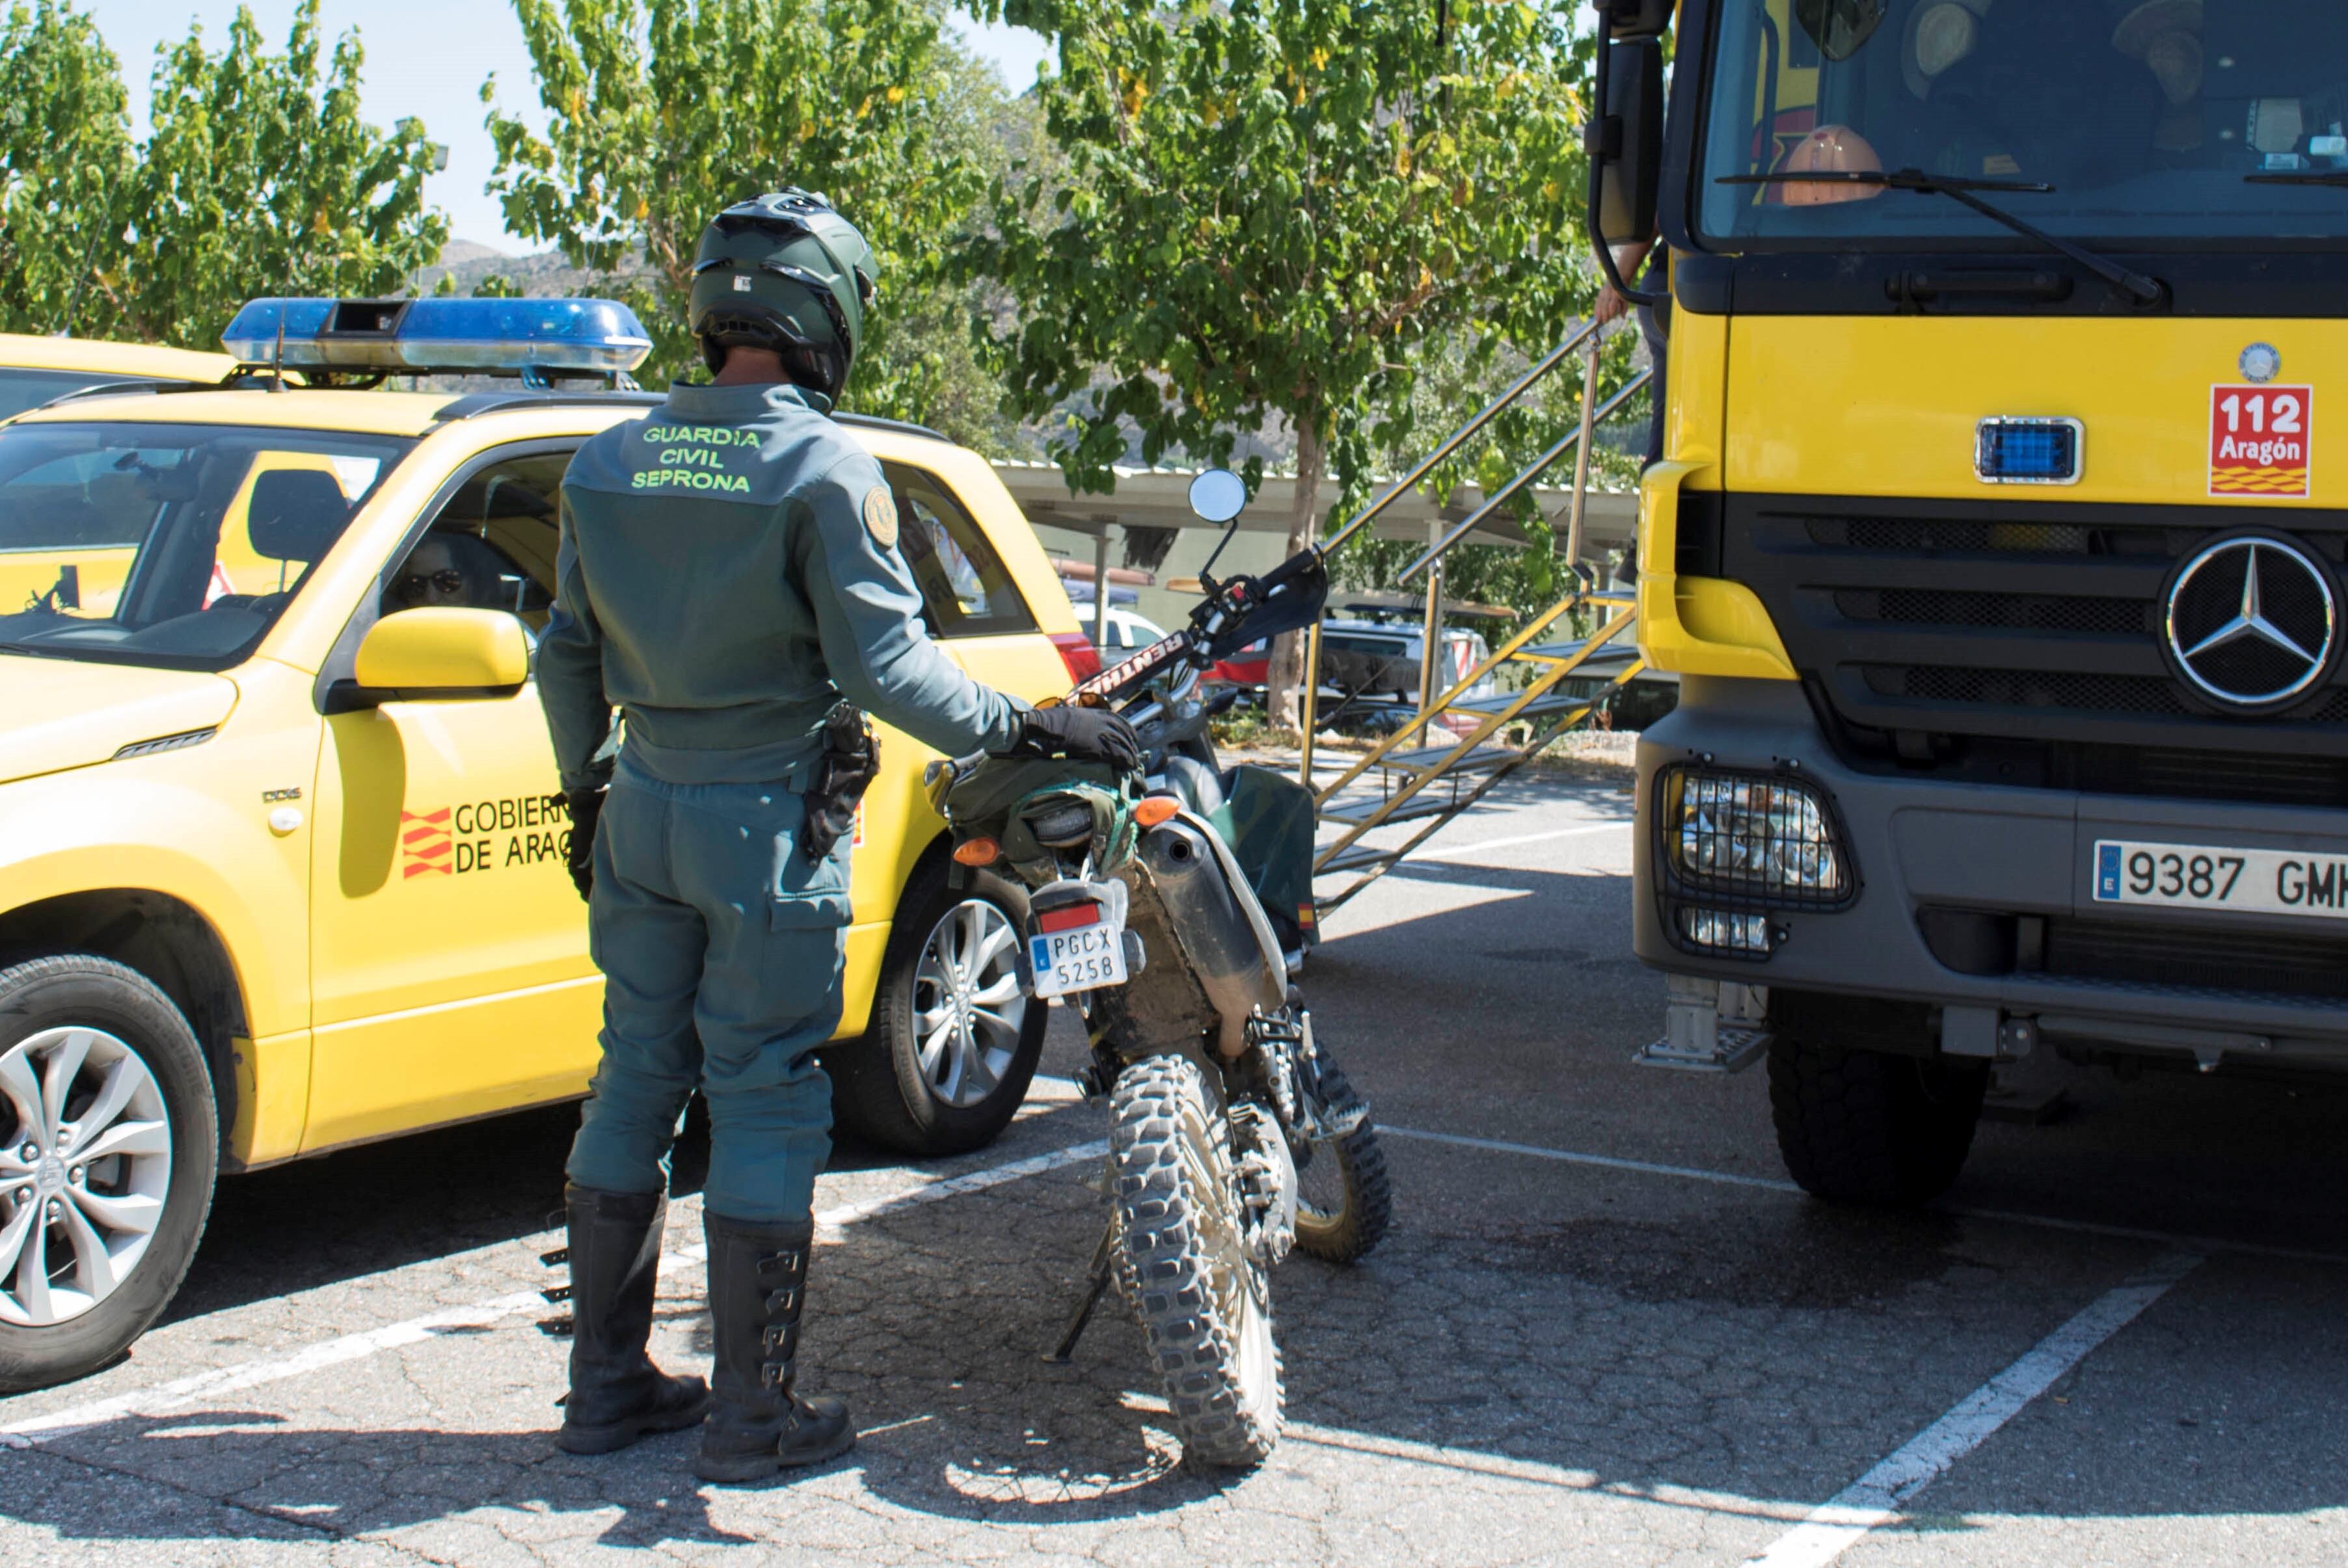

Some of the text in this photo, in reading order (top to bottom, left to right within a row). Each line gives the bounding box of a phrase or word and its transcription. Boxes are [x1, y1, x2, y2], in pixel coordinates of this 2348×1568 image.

[2220, 394, 2301, 433] 112
[643, 426, 761, 448] GUARDIA
[2219, 435, 2301, 466] Aragón
[659, 448, 724, 469] CIVIL
[631, 469, 751, 493] SEPRONA
[457, 839, 491, 874] DE
[2103, 877, 2114, 891] E
[2128, 851, 2245, 900] 9387
[1054, 928, 1111, 958] PGCX
[1058, 956, 1113, 984] 5258
